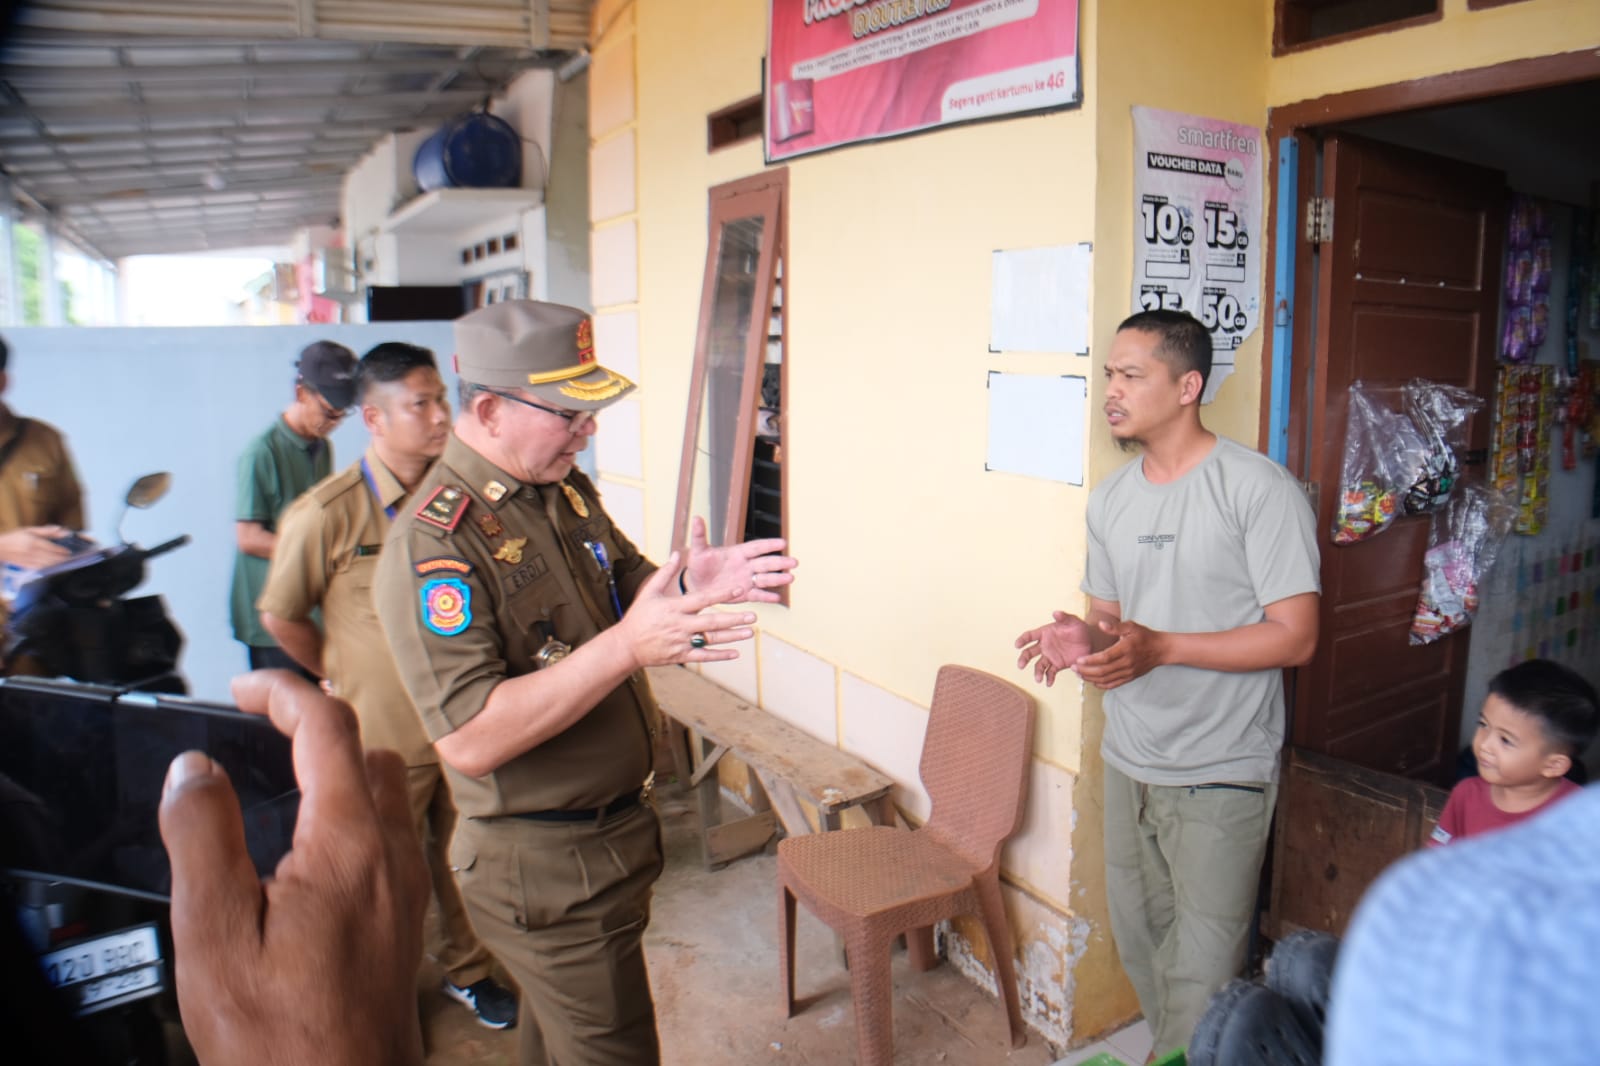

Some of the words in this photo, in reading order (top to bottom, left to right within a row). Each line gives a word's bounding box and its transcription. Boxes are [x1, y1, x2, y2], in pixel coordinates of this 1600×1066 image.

[1034, 79, 1045, 92] ke
[1047, 71, 1065, 91] 4G
[1178, 126, 1257, 154] smartfren
[1150, 154, 1197, 171] VOUCHER
[1198, 164, 1222, 176] DATA
[1142, 203, 1182, 243] 10
[1182, 230, 1194, 241] GB
[1204, 208, 1237, 248] 15
[1238, 235, 1248, 246] GB
[1202, 294, 1239, 332] 50
[1235, 317, 1246, 326] GB
